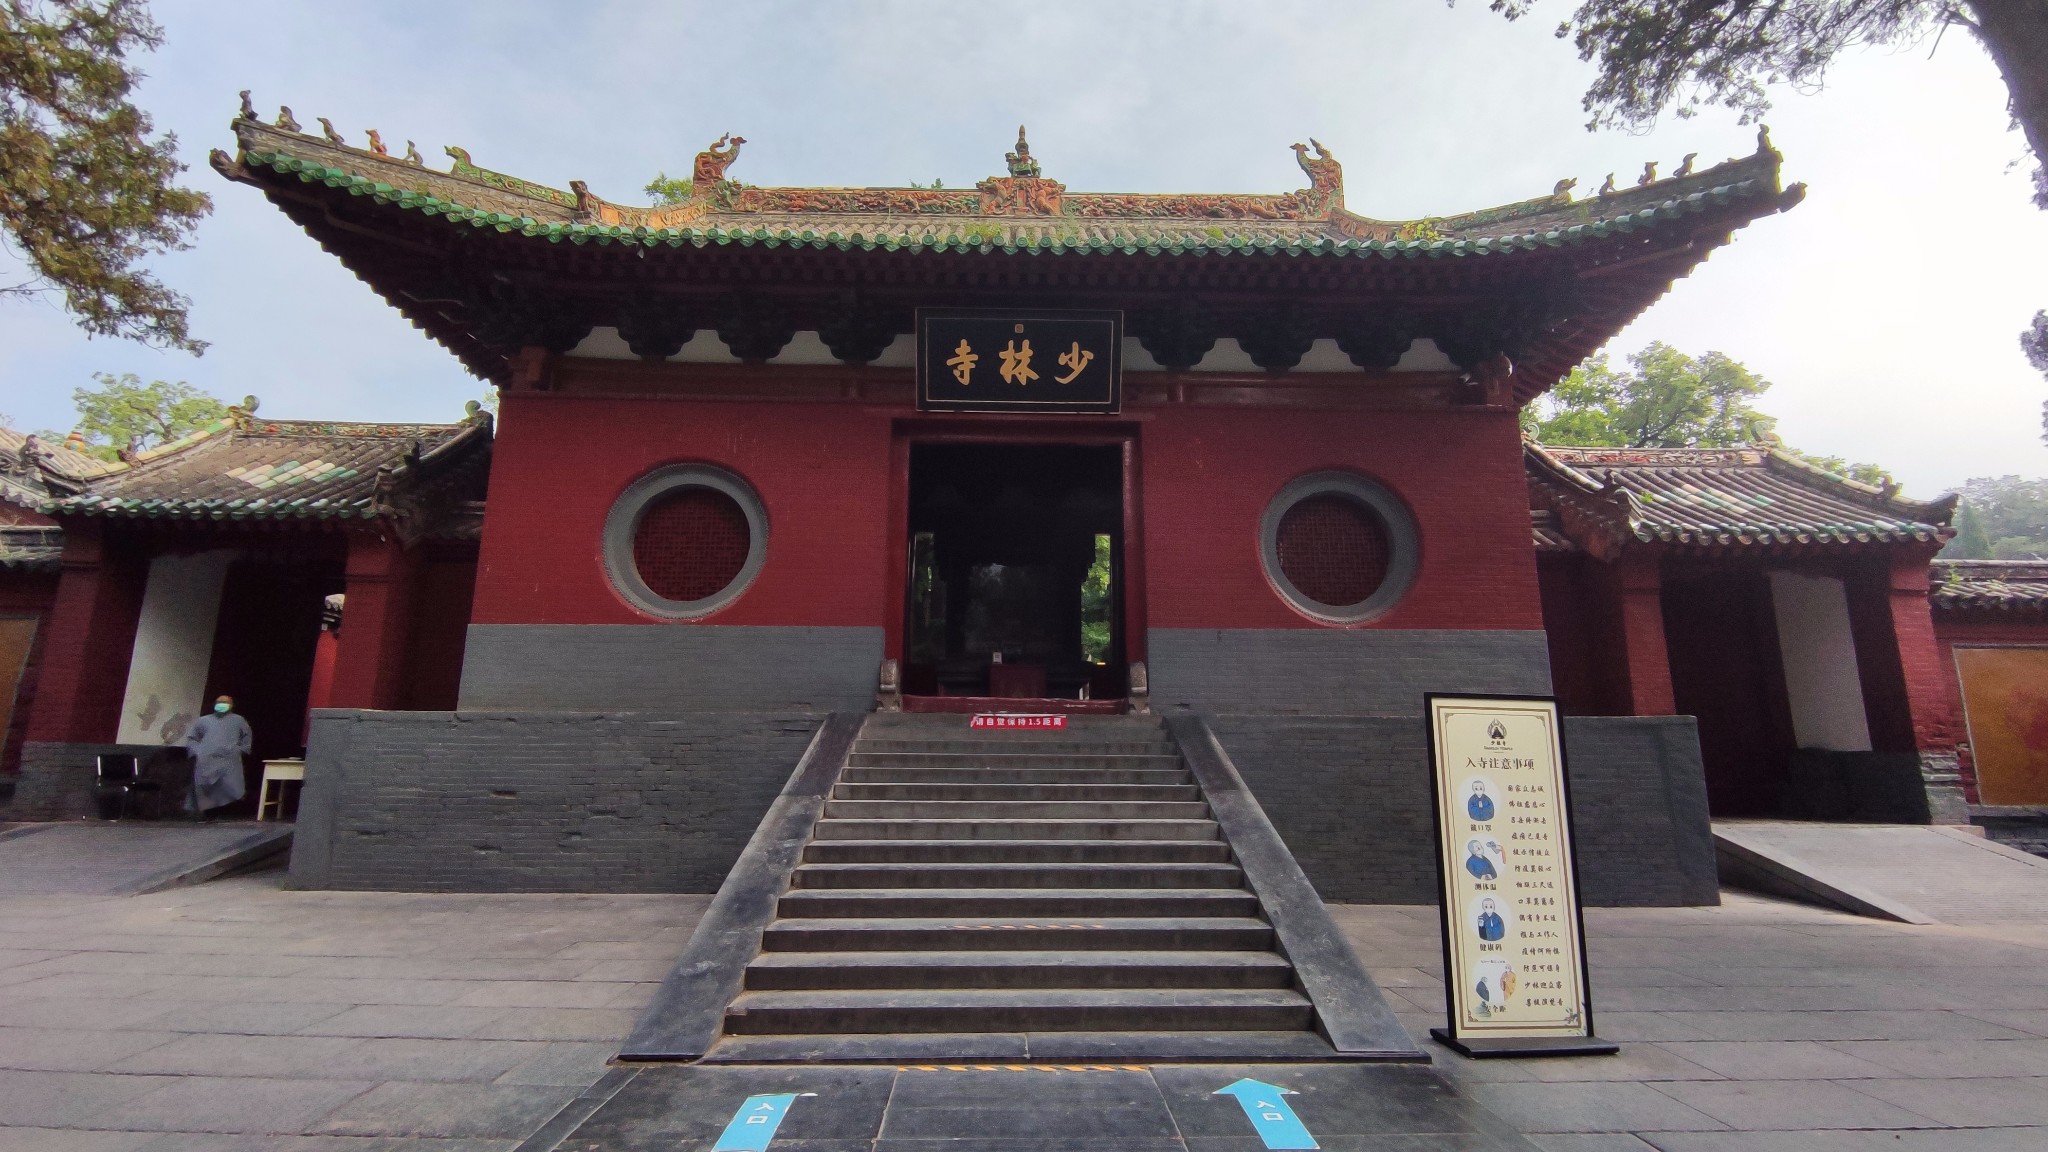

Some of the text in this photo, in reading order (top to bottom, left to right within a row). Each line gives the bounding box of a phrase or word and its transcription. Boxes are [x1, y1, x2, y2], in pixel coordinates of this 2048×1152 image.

[1465, 756, 1535, 770] 入寺注意事项
[1479, 943, 1502, 952] 健康码
[746, 1102, 774, 1124] 入口
[1256, 1101, 1284, 1121] 入口
